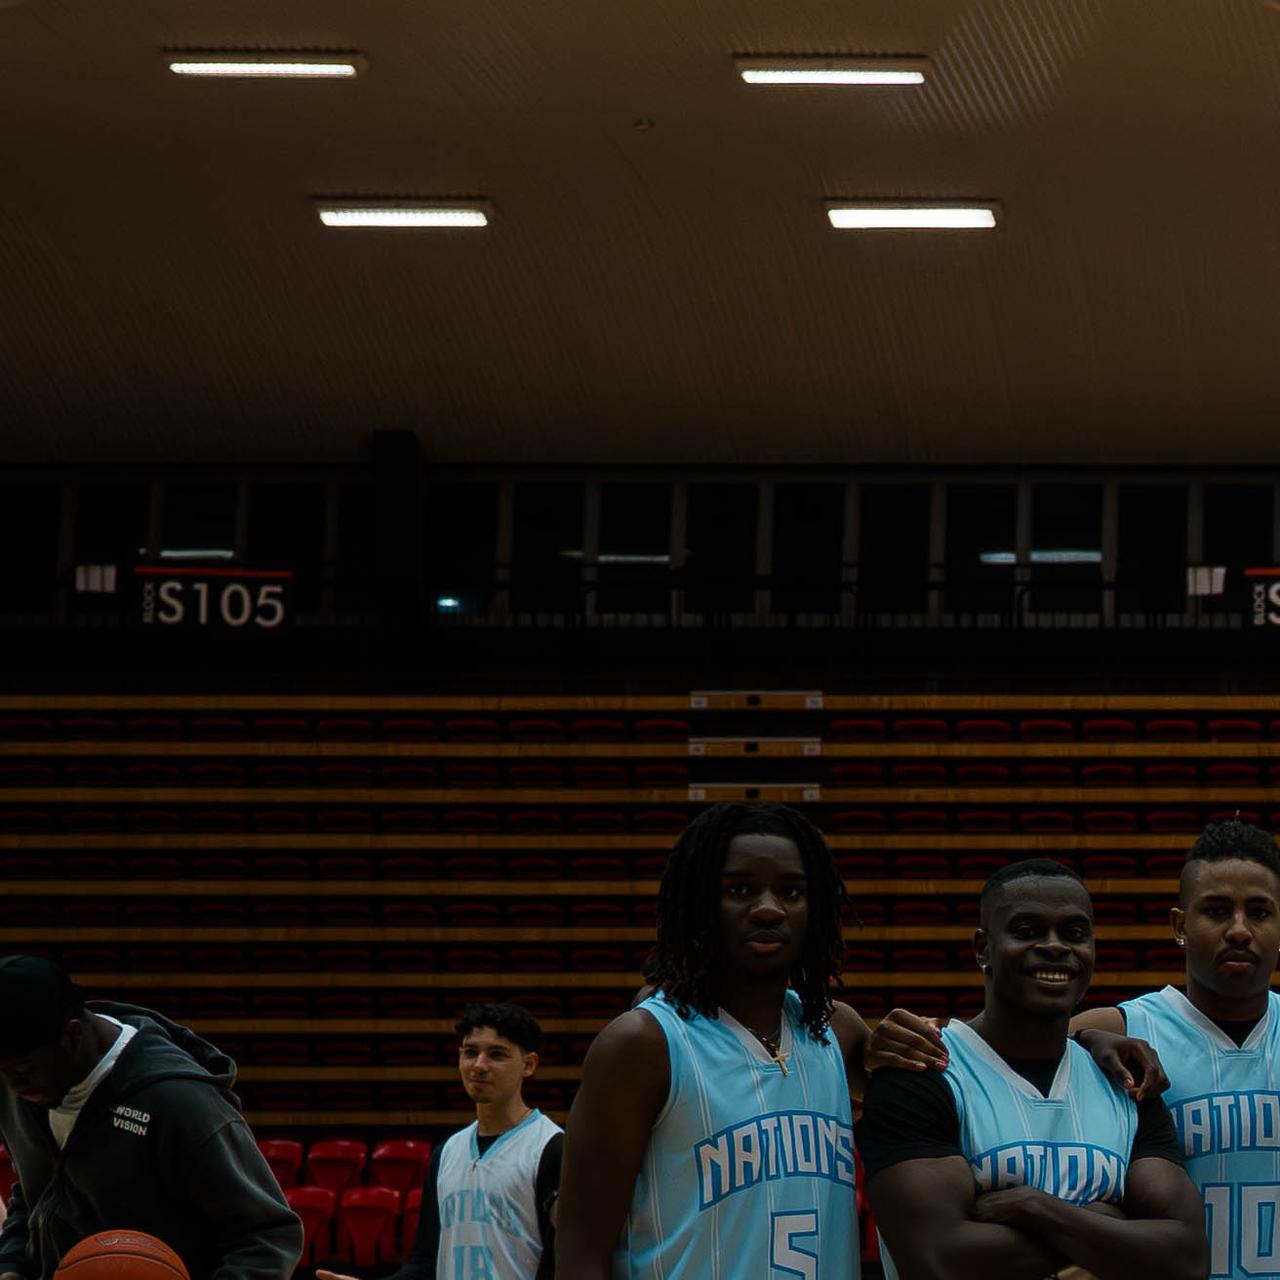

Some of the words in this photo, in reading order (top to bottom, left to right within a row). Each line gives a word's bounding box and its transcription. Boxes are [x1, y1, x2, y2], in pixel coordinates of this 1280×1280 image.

[157, 580, 286, 628] S105
[113, 1104, 151, 1123] WORLD
[113, 1116, 148, 1137] VISION
[693, 1109, 858, 1212] NATIONS
